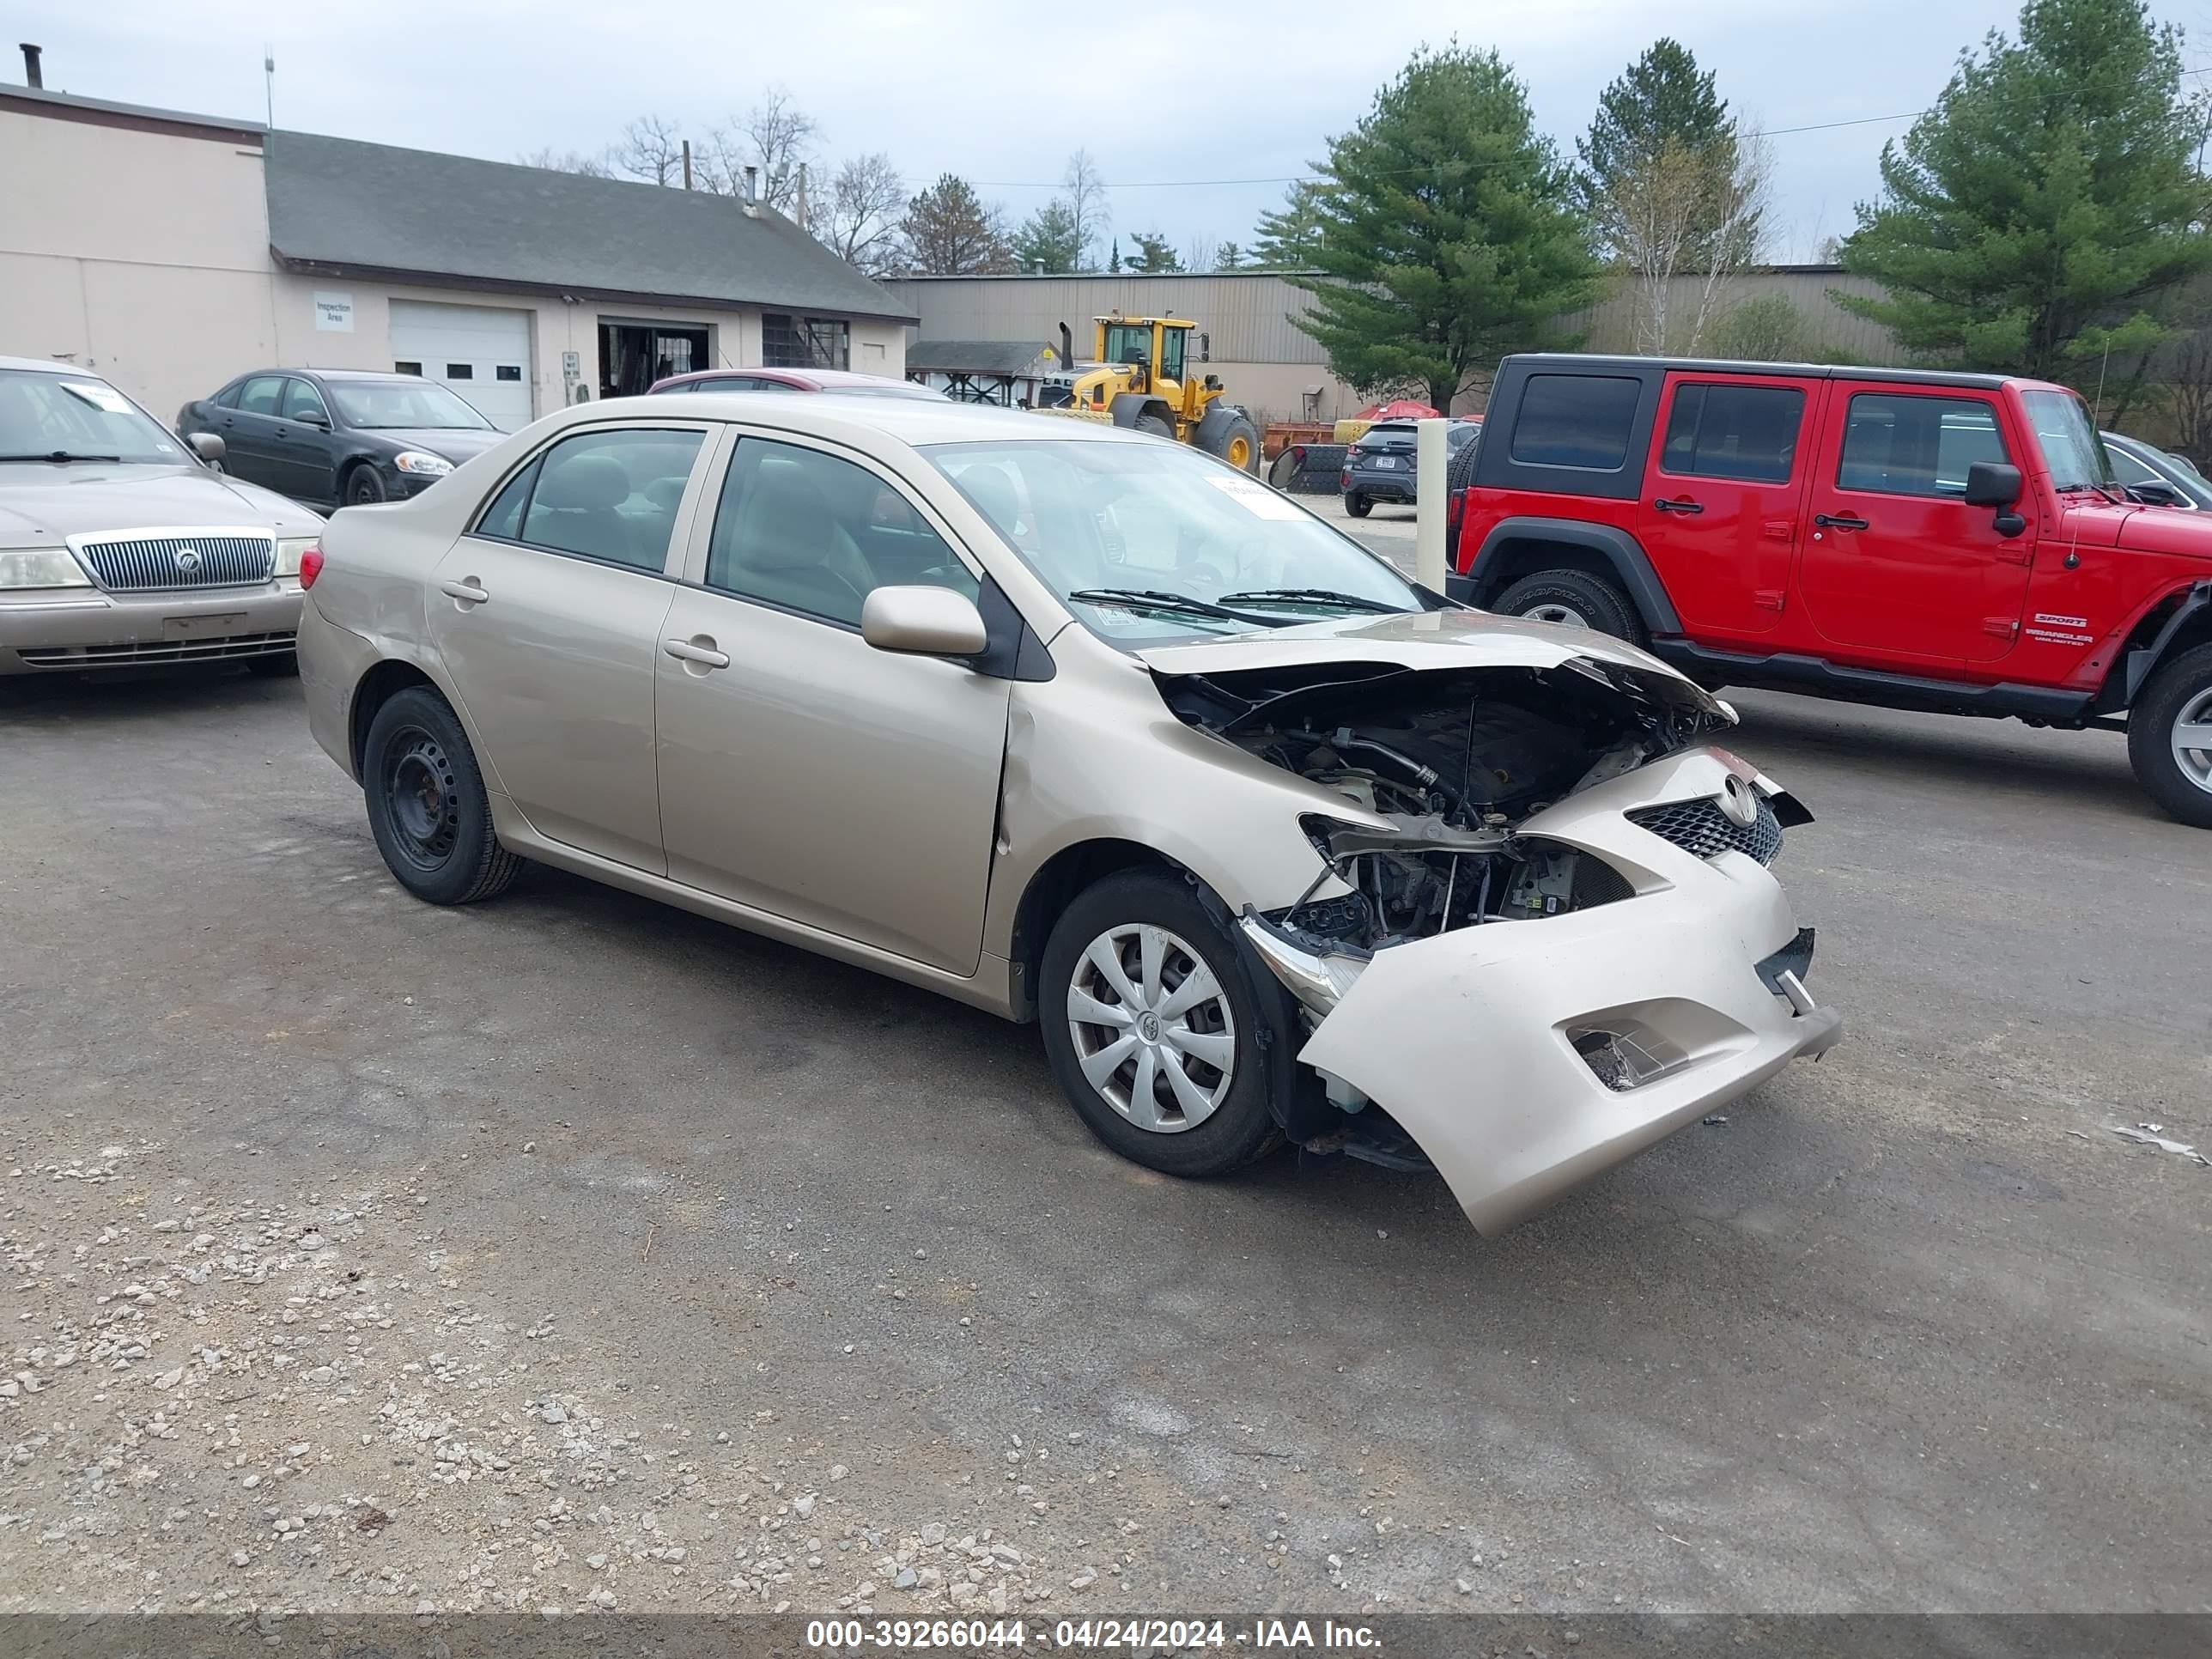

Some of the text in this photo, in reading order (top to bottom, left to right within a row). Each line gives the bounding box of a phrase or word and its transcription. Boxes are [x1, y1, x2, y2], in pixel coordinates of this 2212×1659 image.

[317, 301, 350, 312] Inspection
[327, 313, 343, 322] Area
[2039, 615, 2083, 624] SPORT
[2025, 628, 2094, 643] WRANGLER
[2034, 636, 2085, 647] UNLIMITED
